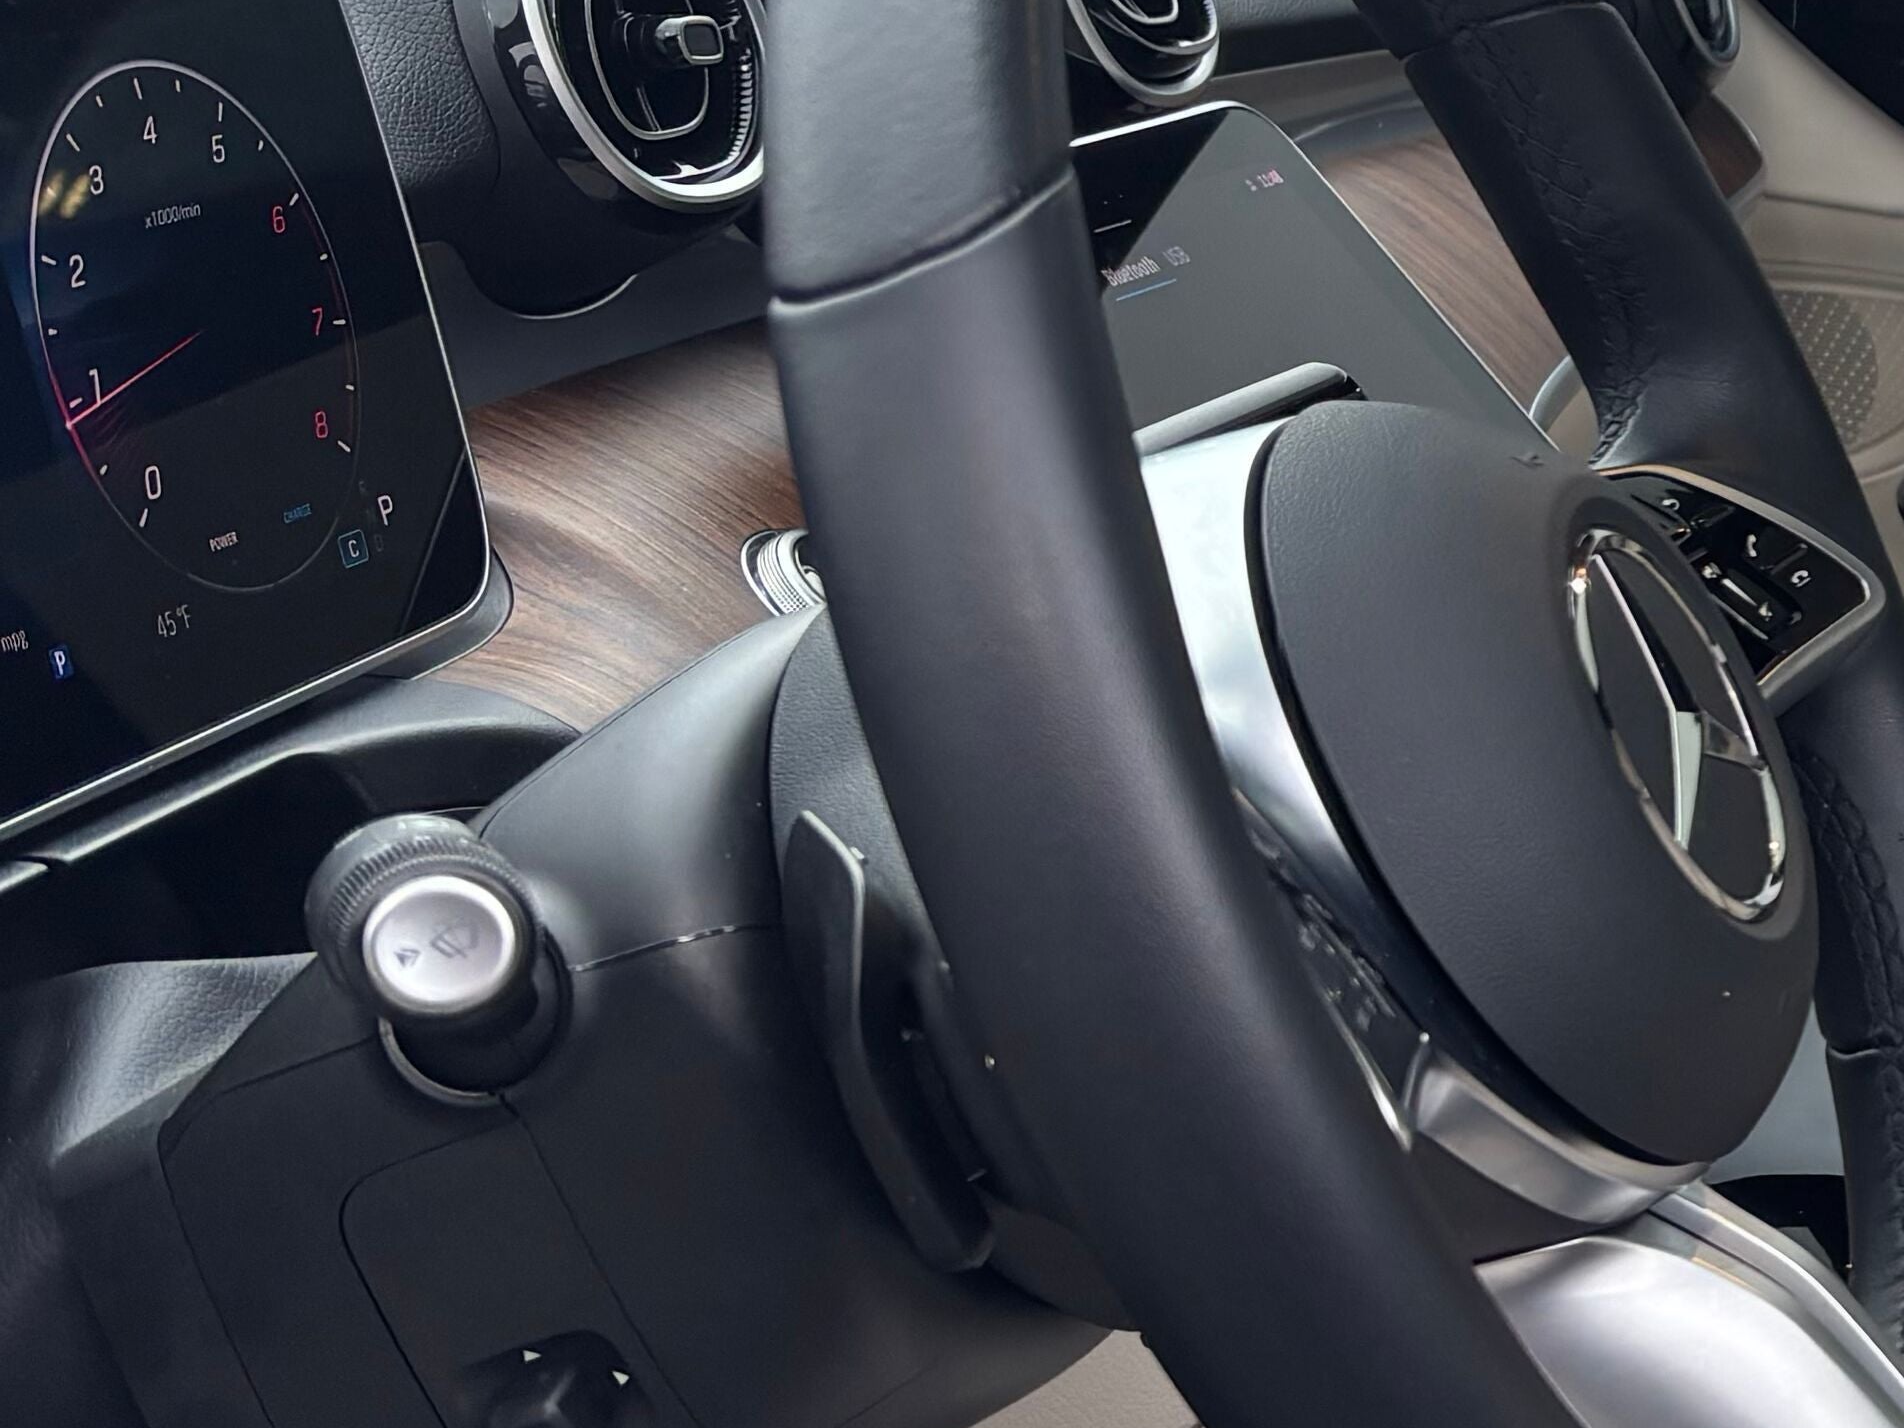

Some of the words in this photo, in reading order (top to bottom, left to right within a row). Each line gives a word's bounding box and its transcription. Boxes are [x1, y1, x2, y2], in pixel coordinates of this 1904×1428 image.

[143, 116, 158, 144] 4
[211, 134, 226, 163] 5
[89, 165, 105, 195] 3
[272, 206, 286, 233] 6
[69, 254, 86, 288] 2
[1101, 256, 1161, 287] Bluetooth
[312, 307, 323, 336] 7
[89, 368, 102, 404] 1
[314, 411, 329, 439] 8
[144, 465, 162, 500] 0
[378, 495, 393, 526] P
[209, 531, 239, 553] POWER
[348, 538, 360, 559] C
[0, 629, 29, 653] mpg
